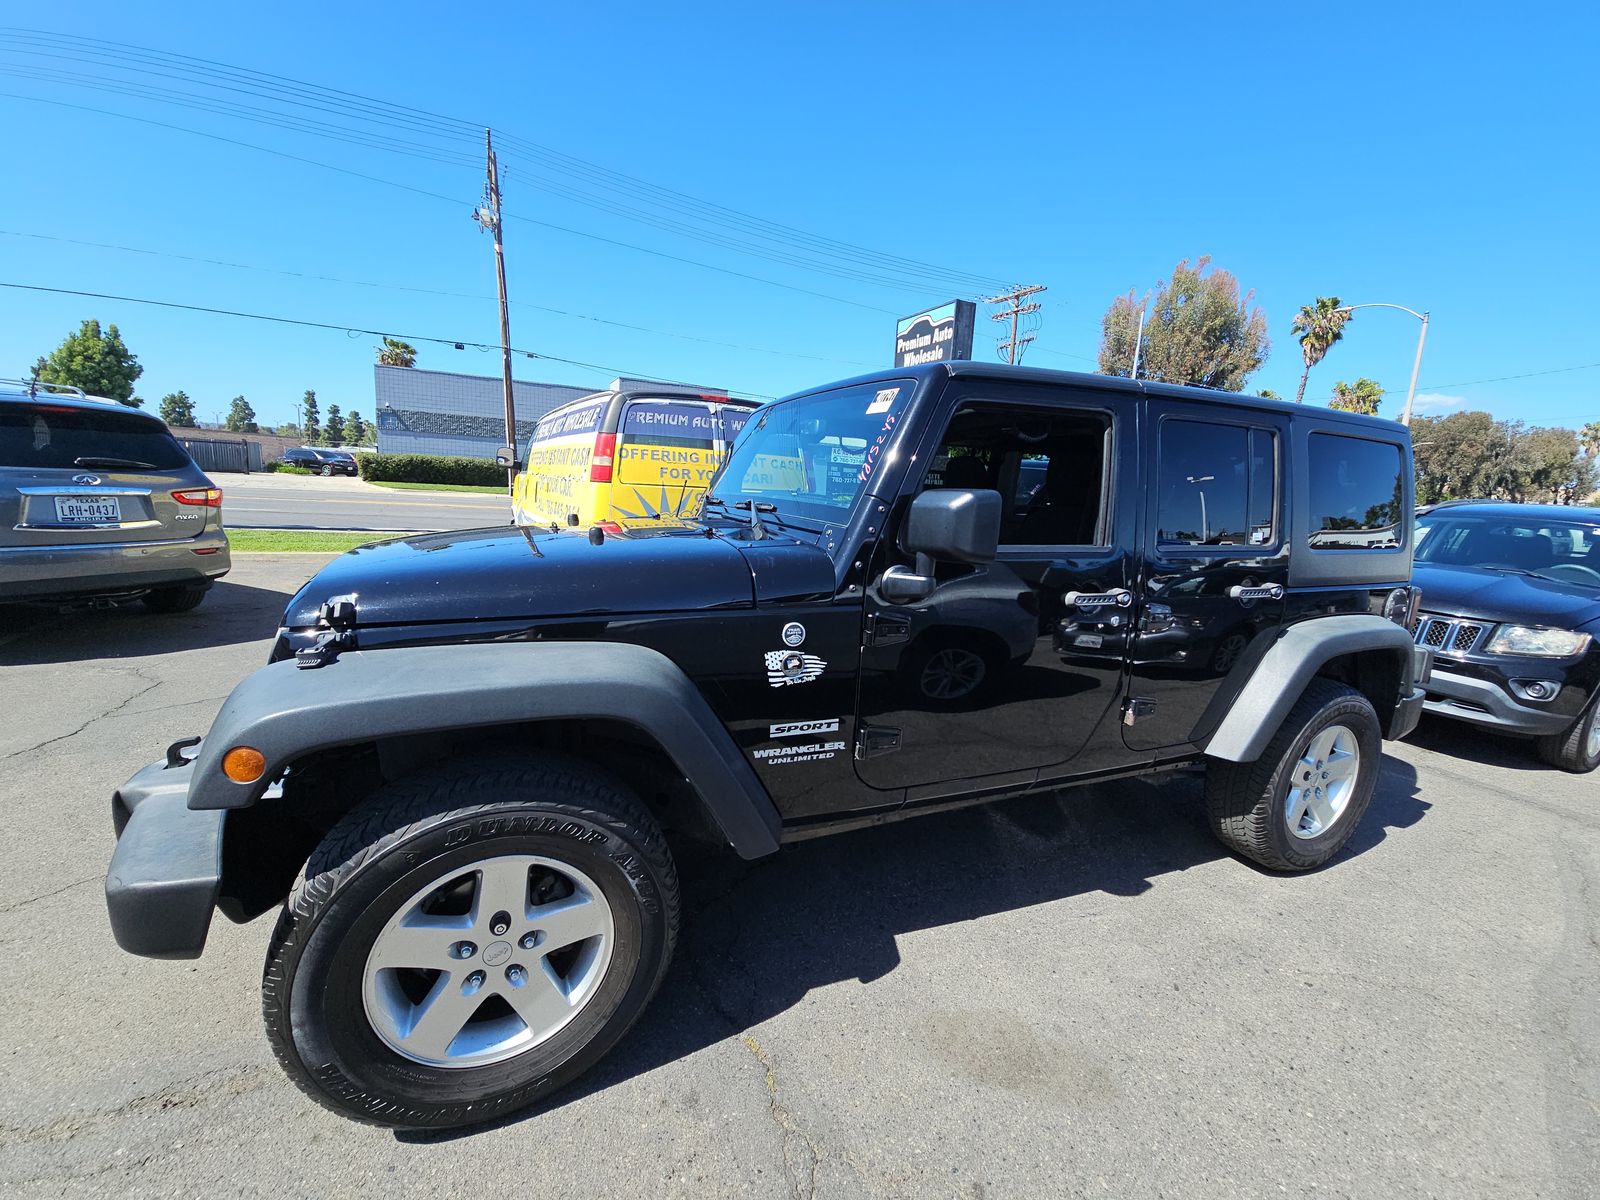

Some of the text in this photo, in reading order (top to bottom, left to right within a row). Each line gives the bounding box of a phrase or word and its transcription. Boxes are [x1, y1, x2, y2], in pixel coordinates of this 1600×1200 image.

[897, 326, 953, 353] Premium Auto
[904, 345, 943, 367] Wholesale
[628, 412, 689, 427] PREMIUM
[692, 417, 727, 430] AUTO
[617, 448, 699, 463] OFFERING
[660, 467, 691, 480] FOR
[774, 722, 834, 734] SPORT
[753, 741, 846, 758] WRANGLER
[768, 752, 835, 765] UNLIMITED
[444, 815, 608, 847] DUNLOP
